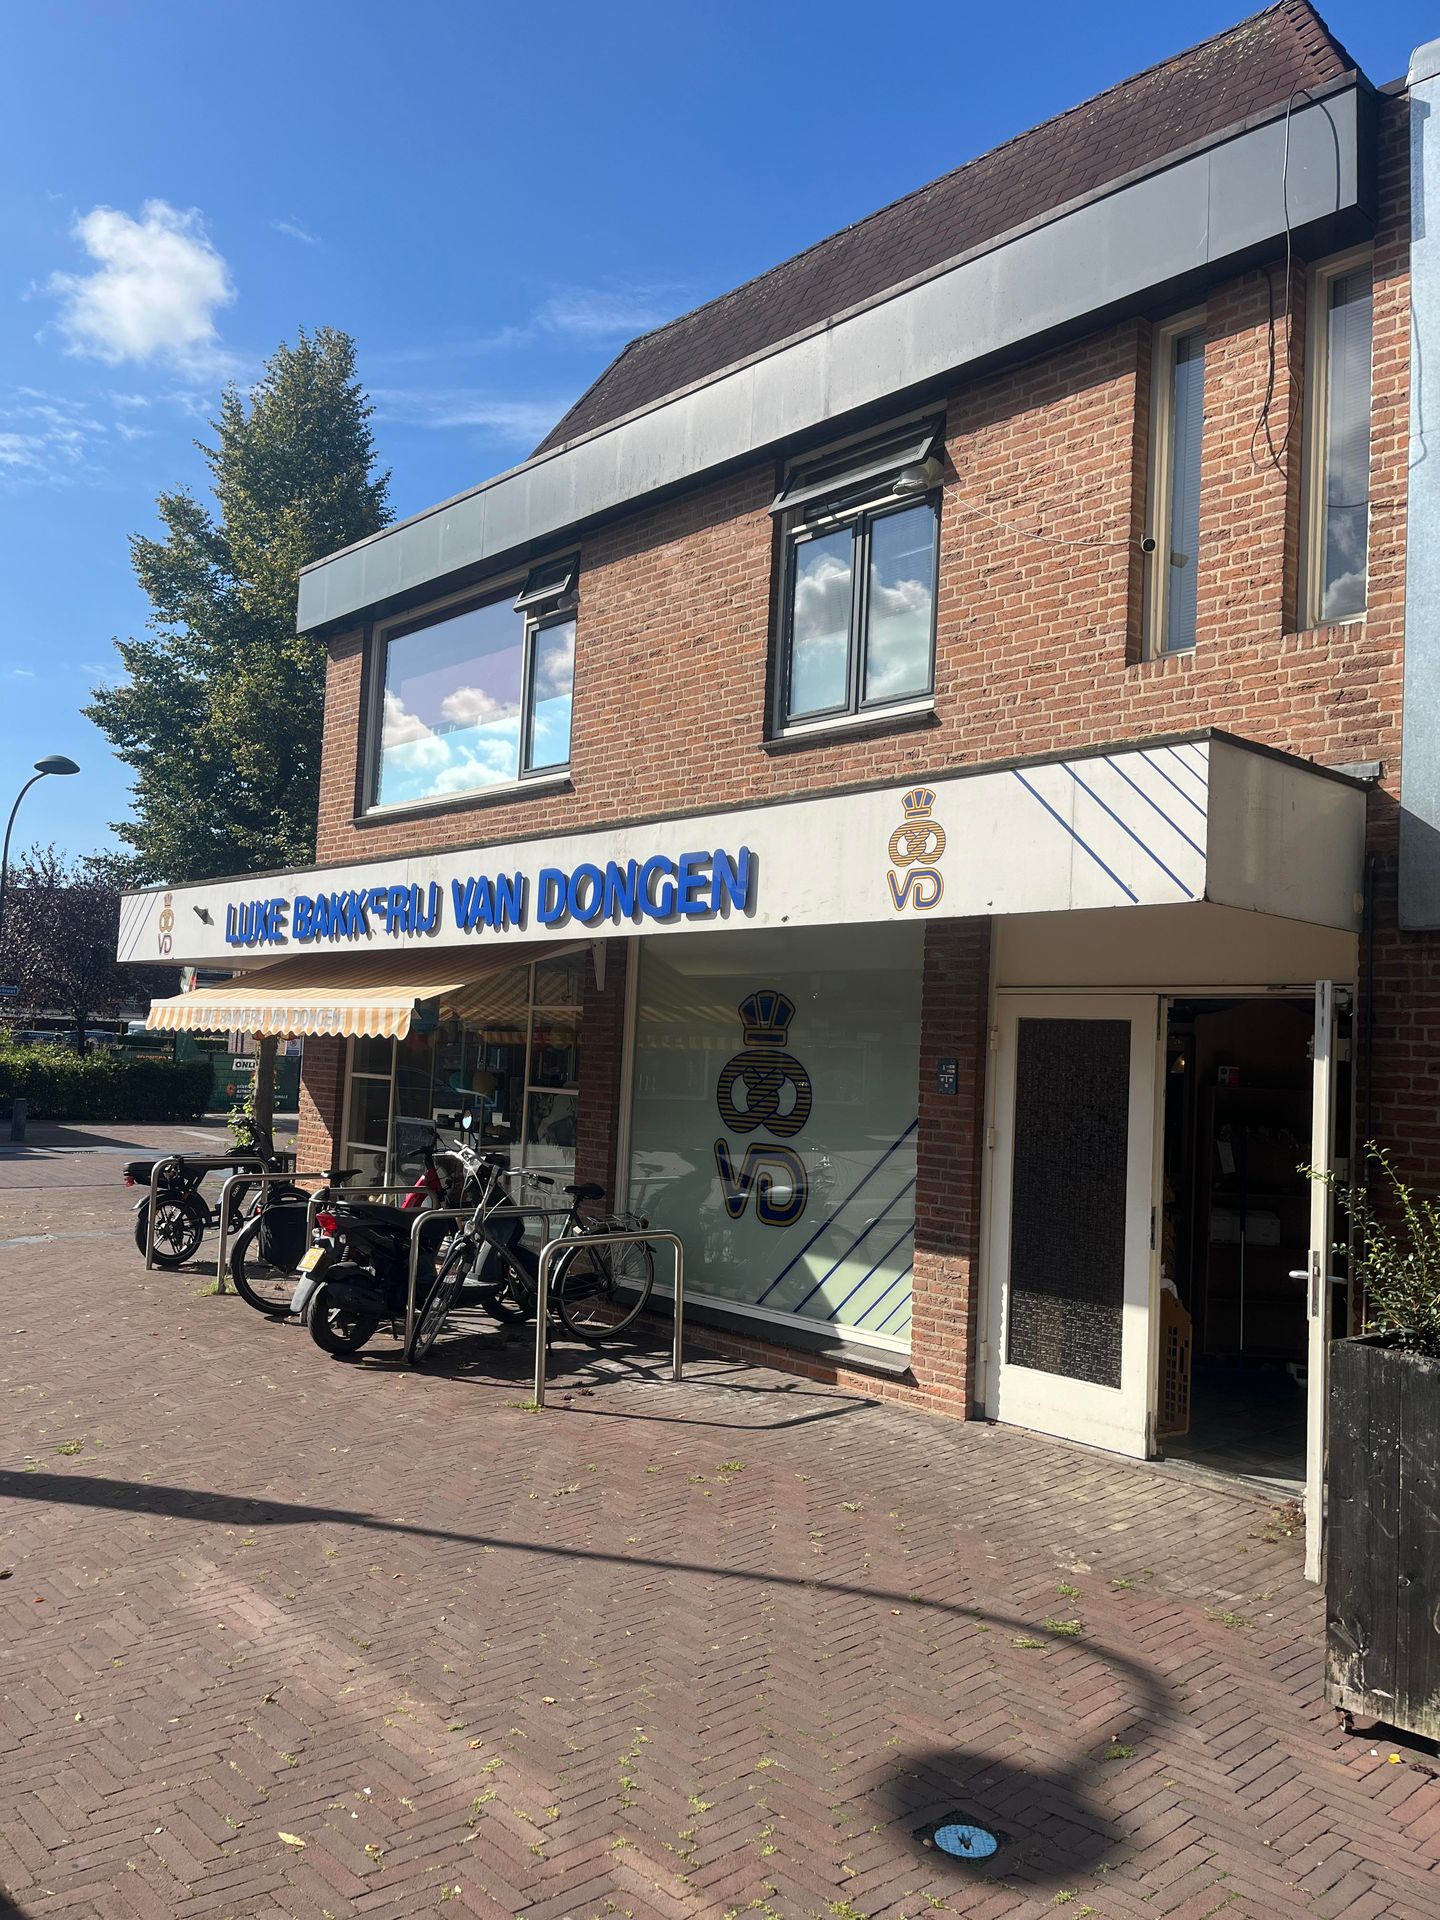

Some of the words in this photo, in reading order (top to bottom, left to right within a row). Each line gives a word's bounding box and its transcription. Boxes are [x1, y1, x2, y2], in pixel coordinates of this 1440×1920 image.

[225, 898, 285, 943] LUXE
[451, 872, 524, 929] VAN
[536, 845, 750, 923] DONGEN
[886, 867, 944, 912] VD
[157, 932, 173, 956] VD
[713, 1137, 809, 1228] VD
